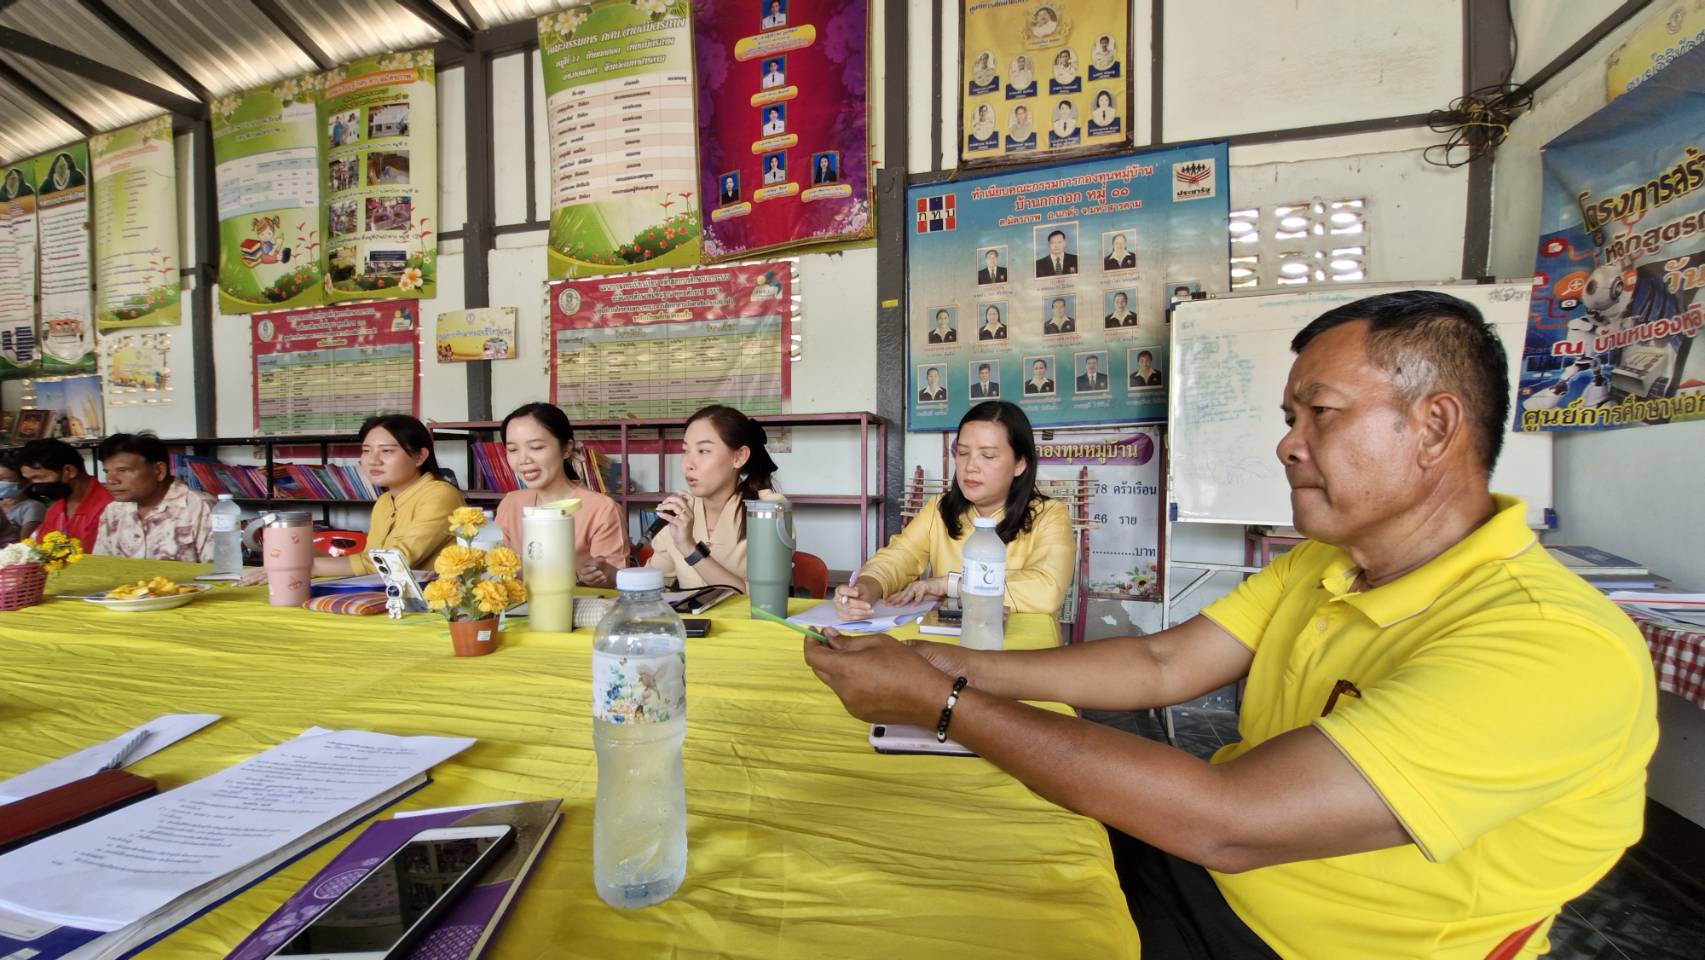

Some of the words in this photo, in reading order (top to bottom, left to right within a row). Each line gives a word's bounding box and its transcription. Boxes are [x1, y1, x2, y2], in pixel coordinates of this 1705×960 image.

[971, 164, 1154, 201] ทำเนียบคณะกรรมการกองทุนหมู่บ้าน
[1014, 192, 1083, 212] บ้านกกกอก
[1086, 183, 1108, 205] หมู่
[1552, 341, 1585, 355] ณ
[1594, 303, 1705, 352] บ้านหนองหูลิ
[1113, 481, 1158, 496] ครัวเรือน
[1119, 515, 1138, 526] ราย
